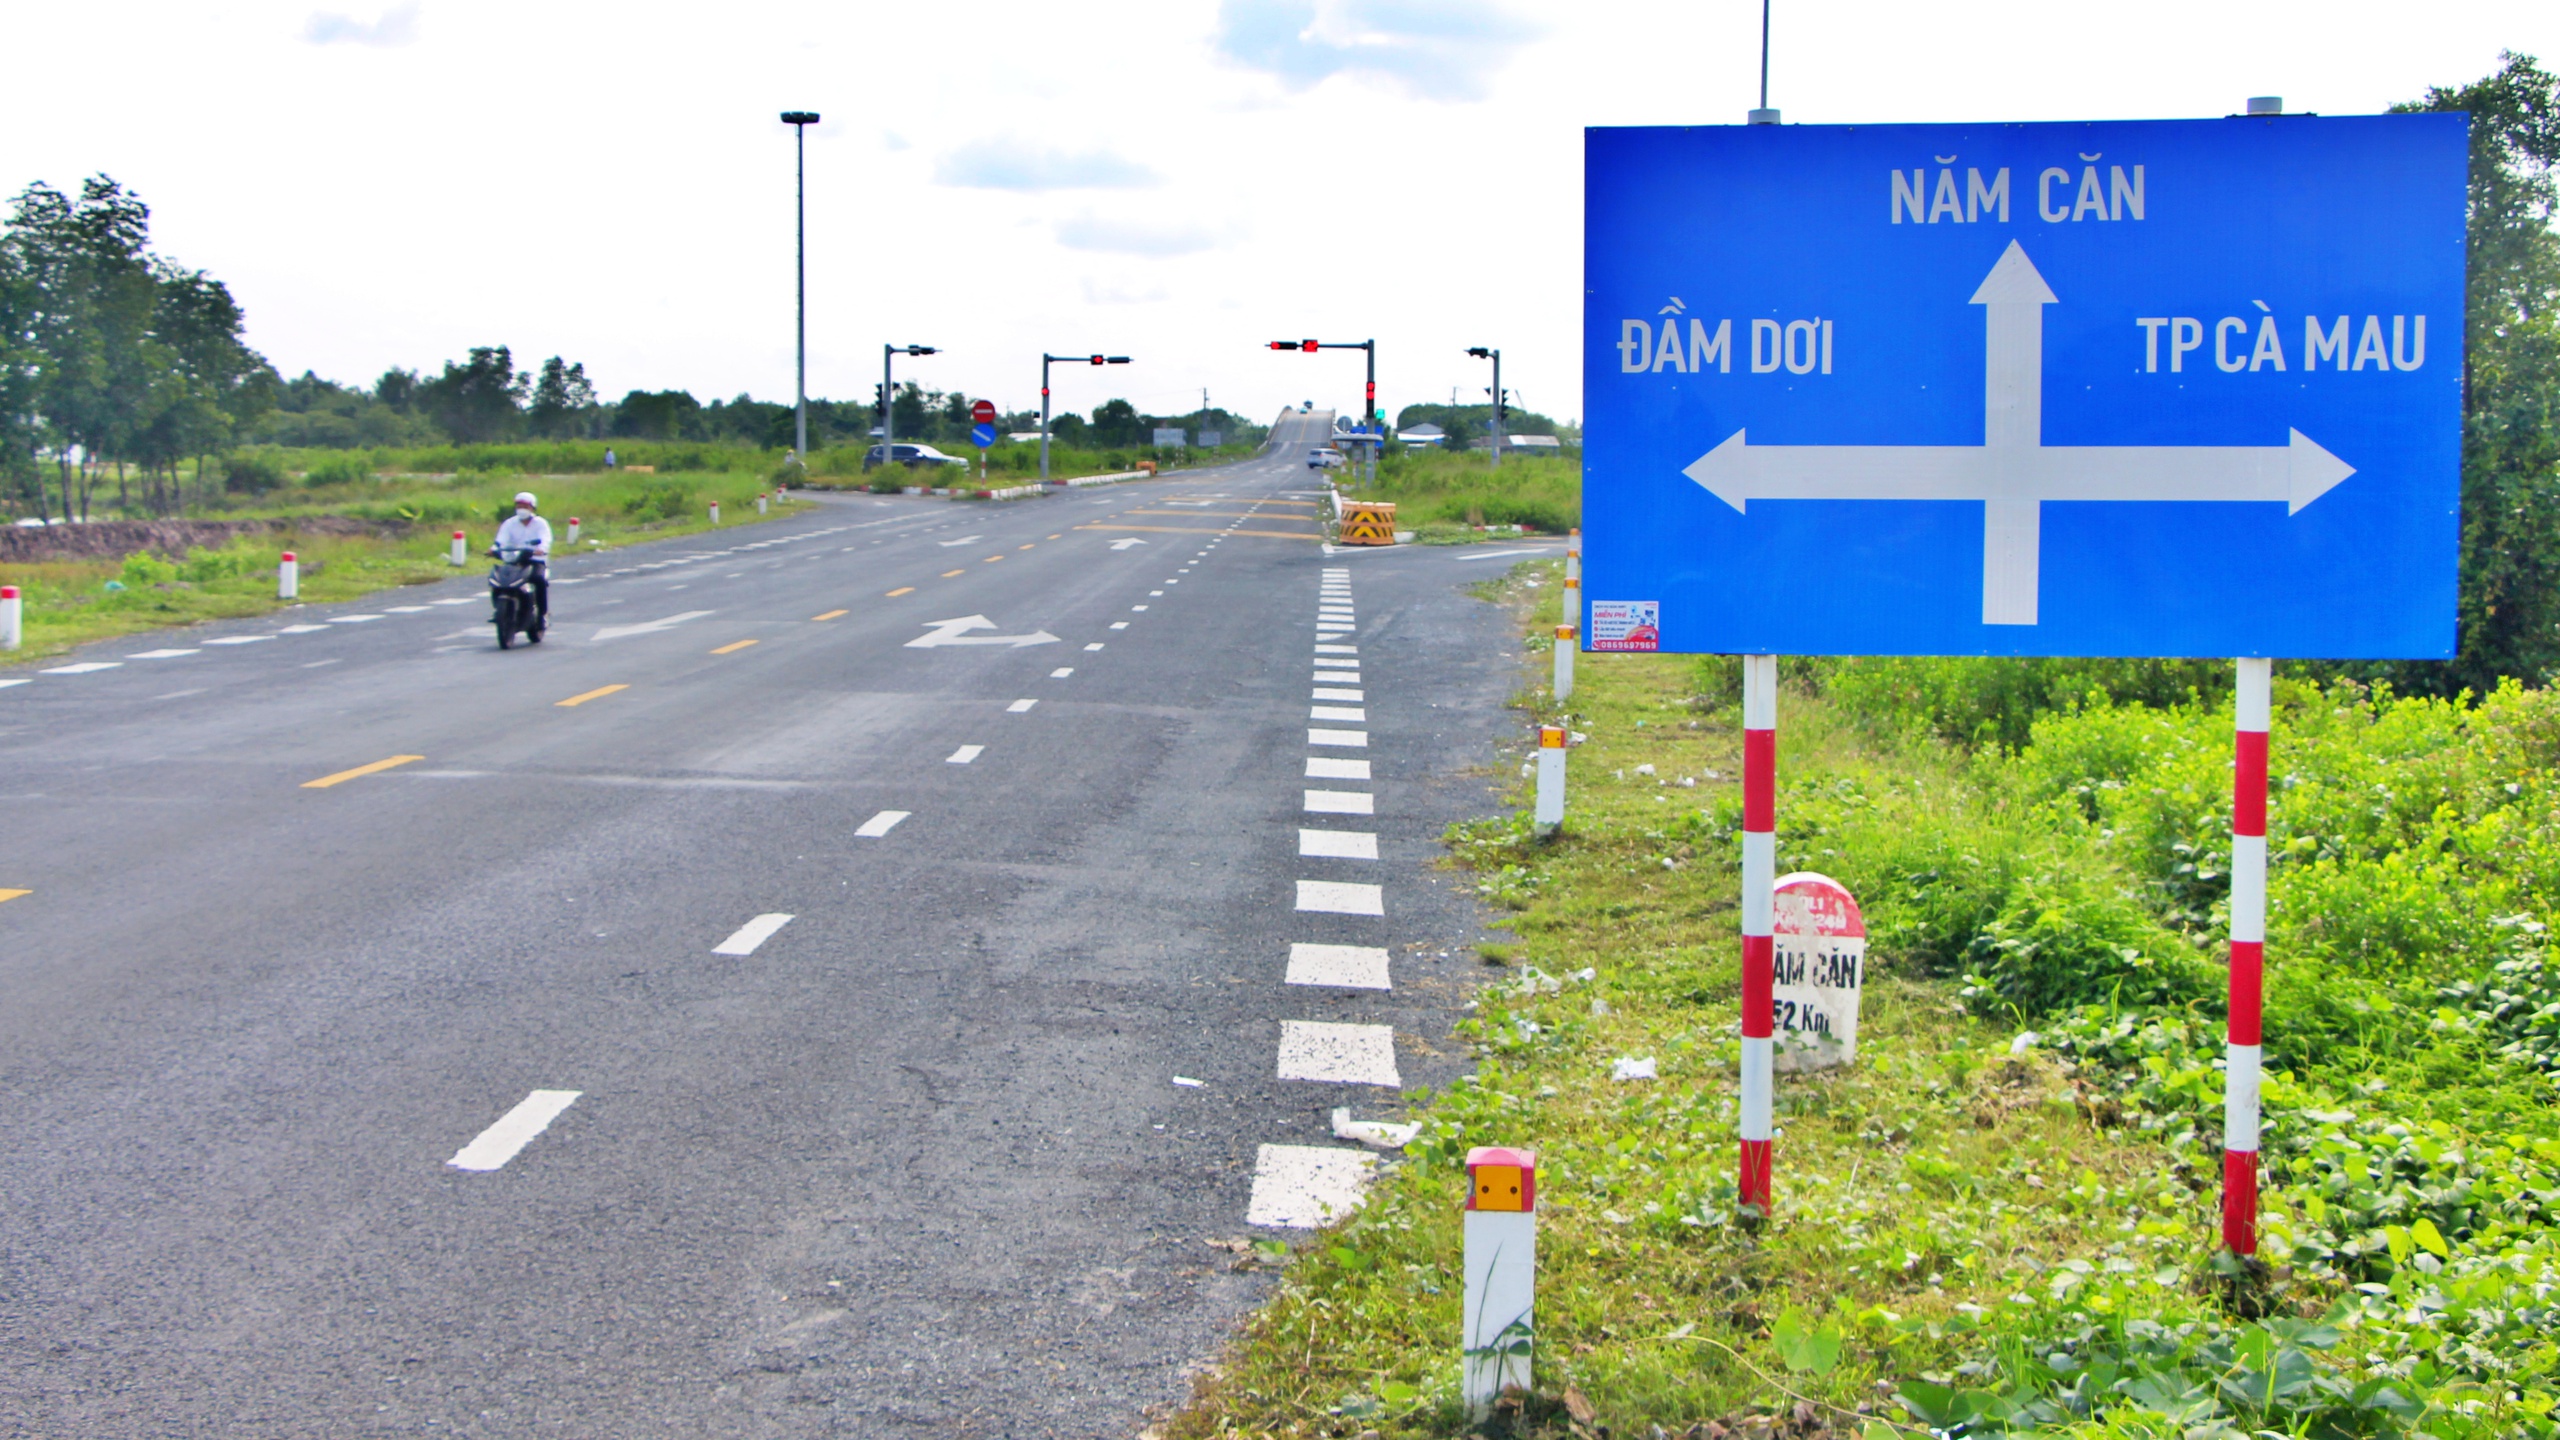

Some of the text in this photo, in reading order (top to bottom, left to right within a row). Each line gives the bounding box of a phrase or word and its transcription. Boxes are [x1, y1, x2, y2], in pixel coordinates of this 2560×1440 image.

[1891, 152, 2145, 224] NĂM CĂN
[1617, 296, 1833, 375] ĐẦM DƠI
[2136, 299, 2426, 373] TP CÀ MAU
[1773, 943, 1857, 989] ĂM CĂN
